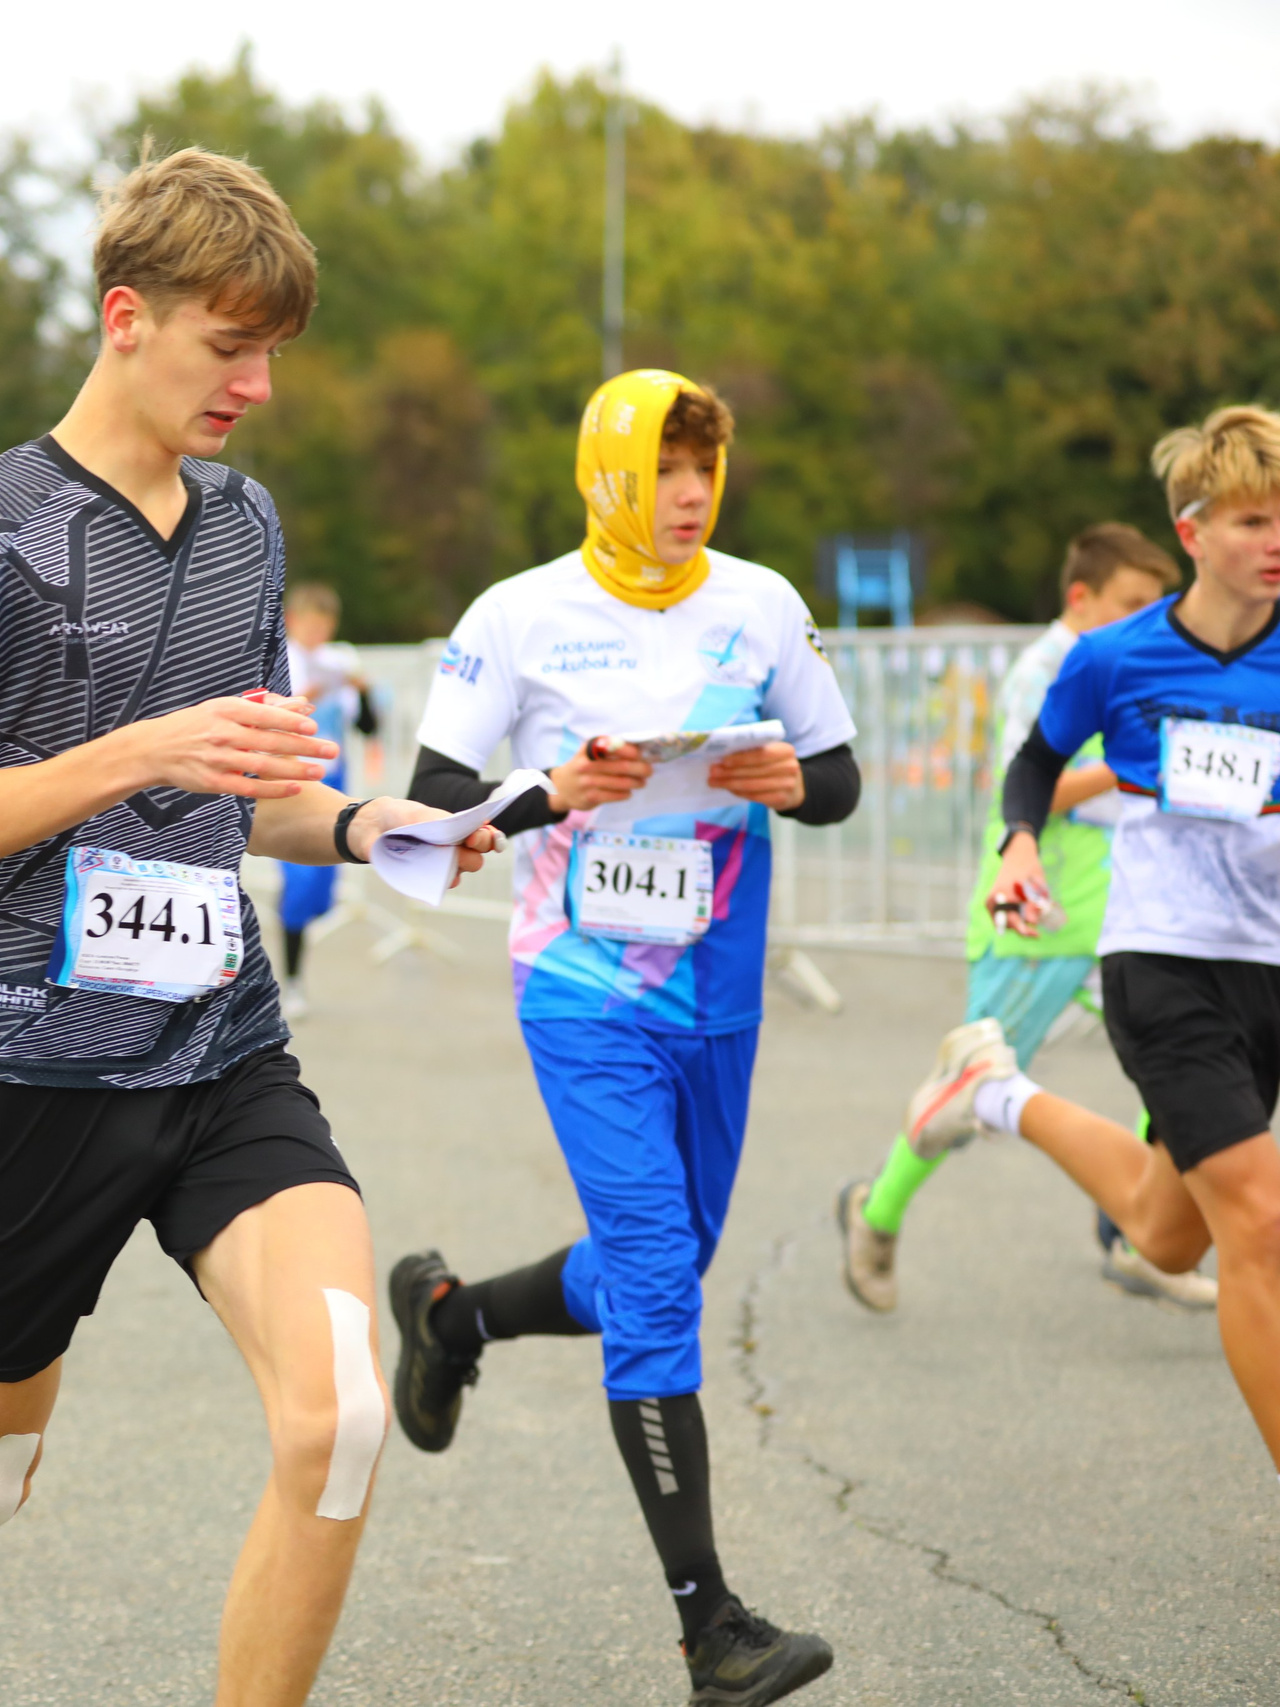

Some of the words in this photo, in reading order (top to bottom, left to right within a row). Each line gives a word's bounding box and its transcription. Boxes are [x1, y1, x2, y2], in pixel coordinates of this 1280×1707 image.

[1172, 745, 1261, 785] 348.1
[586, 859, 688, 900] 304.1
[86, 892, 216, 946] 344.1
